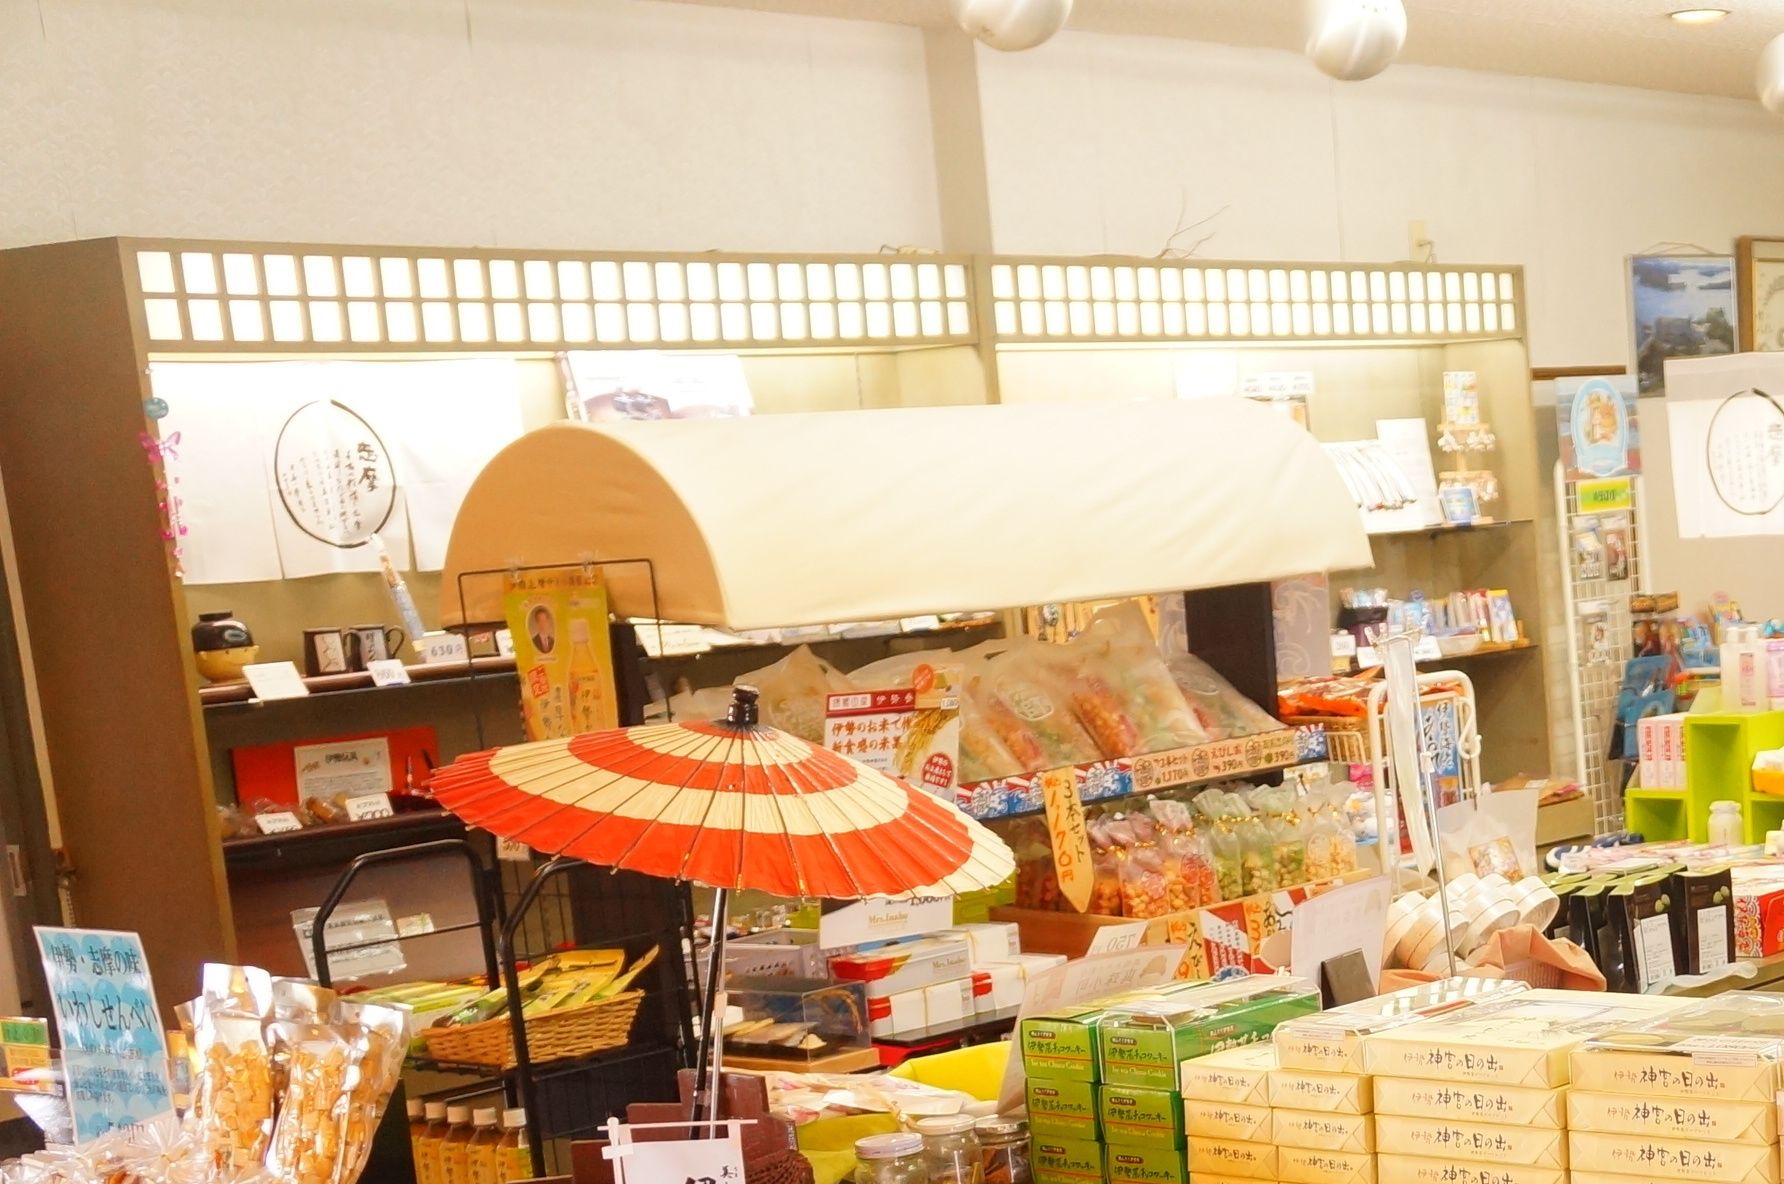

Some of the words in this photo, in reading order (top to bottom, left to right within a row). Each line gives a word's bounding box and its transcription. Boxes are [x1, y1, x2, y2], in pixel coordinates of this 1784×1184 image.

[57, 991, 157, 1032] いわしせんべい
